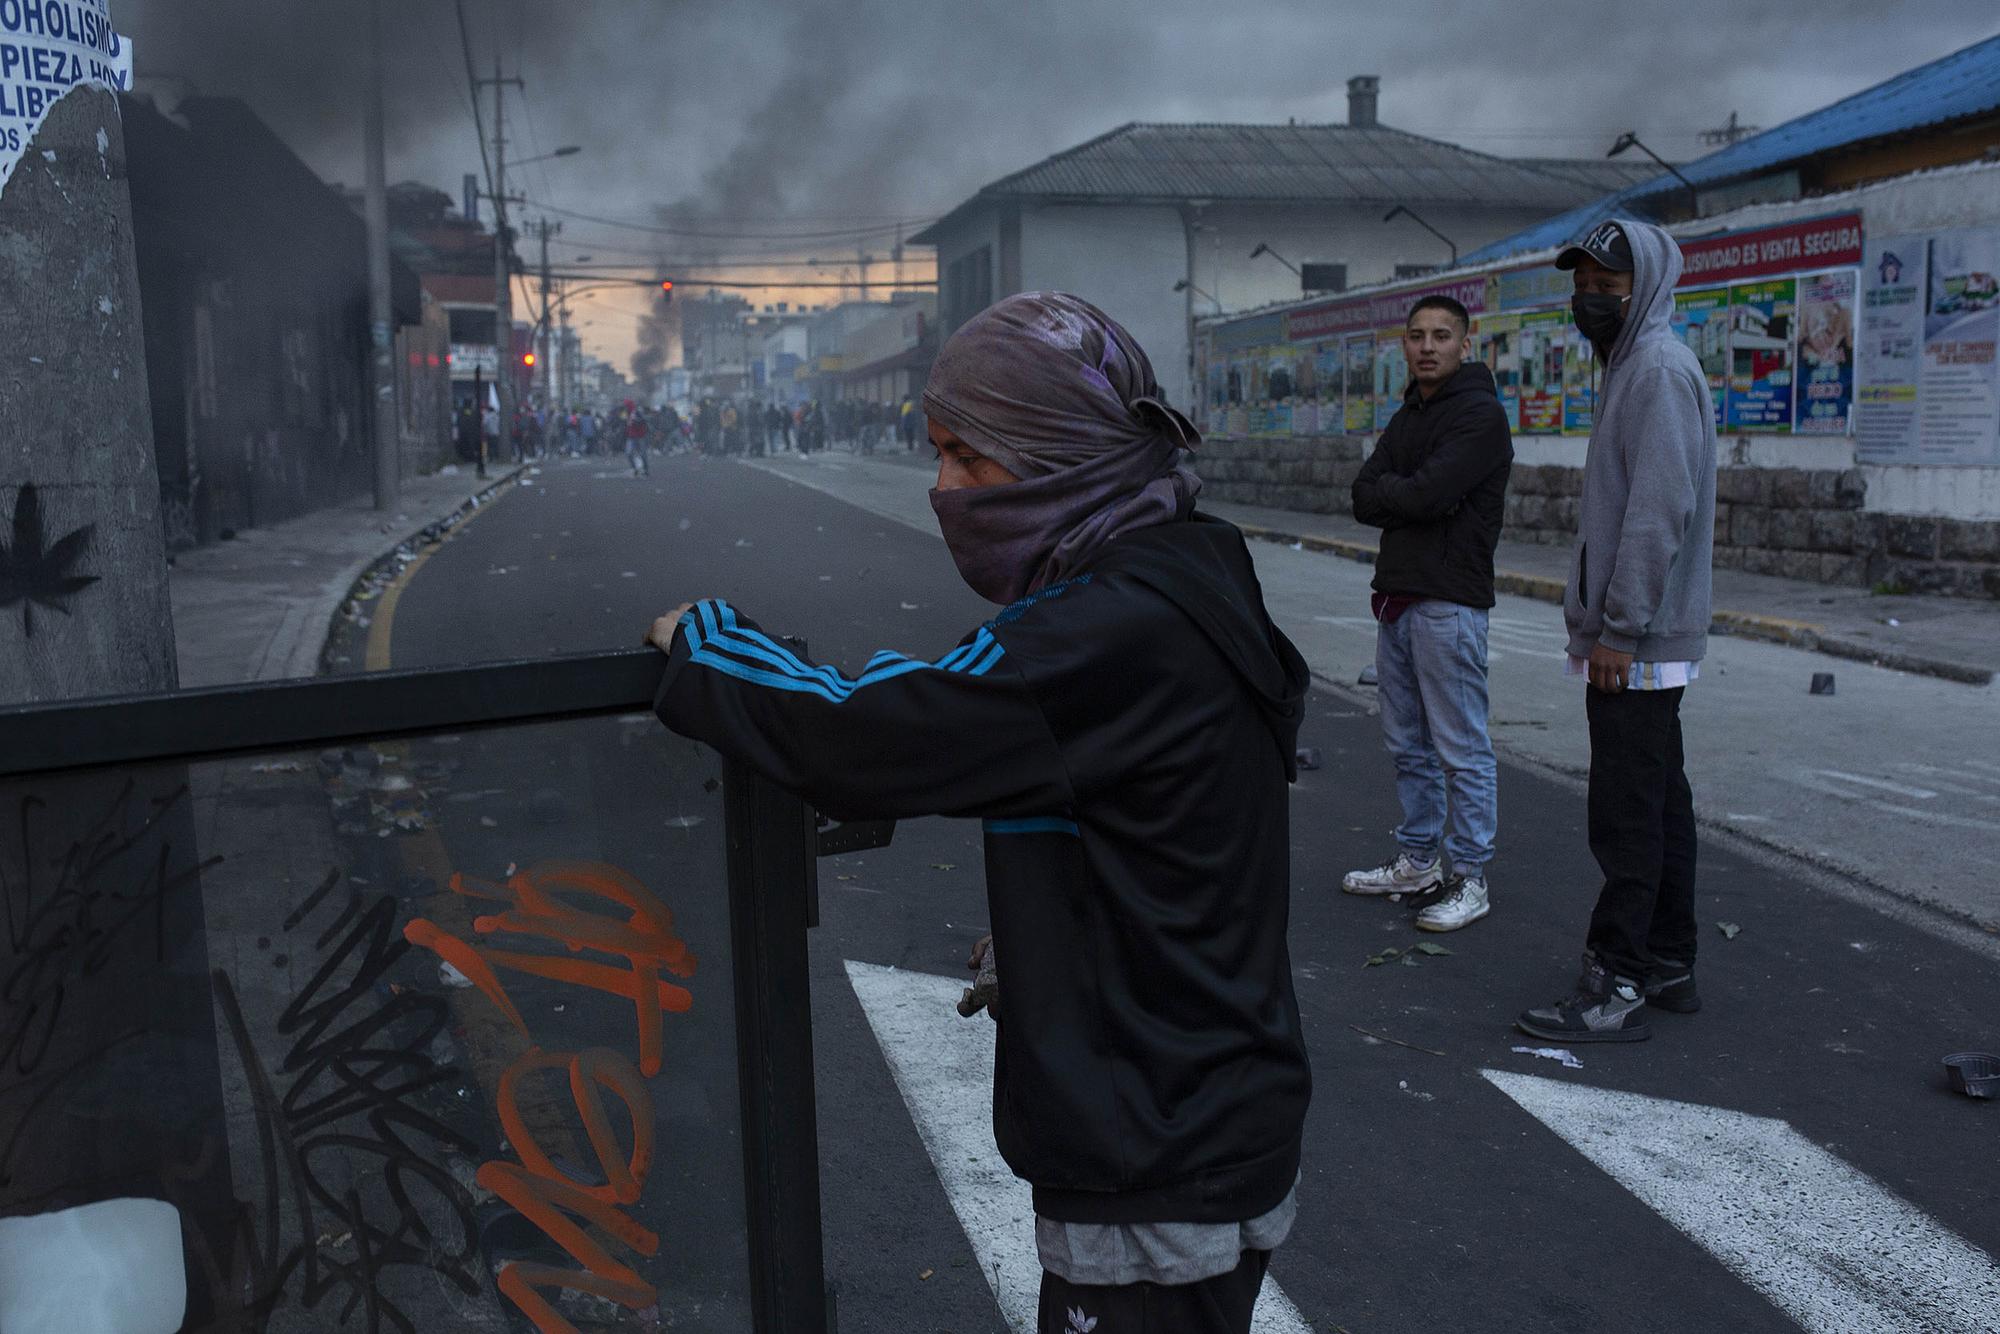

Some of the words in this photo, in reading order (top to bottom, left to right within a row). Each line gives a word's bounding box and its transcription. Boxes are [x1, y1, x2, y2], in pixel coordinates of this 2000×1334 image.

[0, 0, 120, 58] OHOLISMO
[1, 44, 83, 84] PIEZA
[1743, 243, 1758, 265] ES
[1761, 238, 1801, 262] VENTA
[1804, 226, 1859, 257] SEGURA
